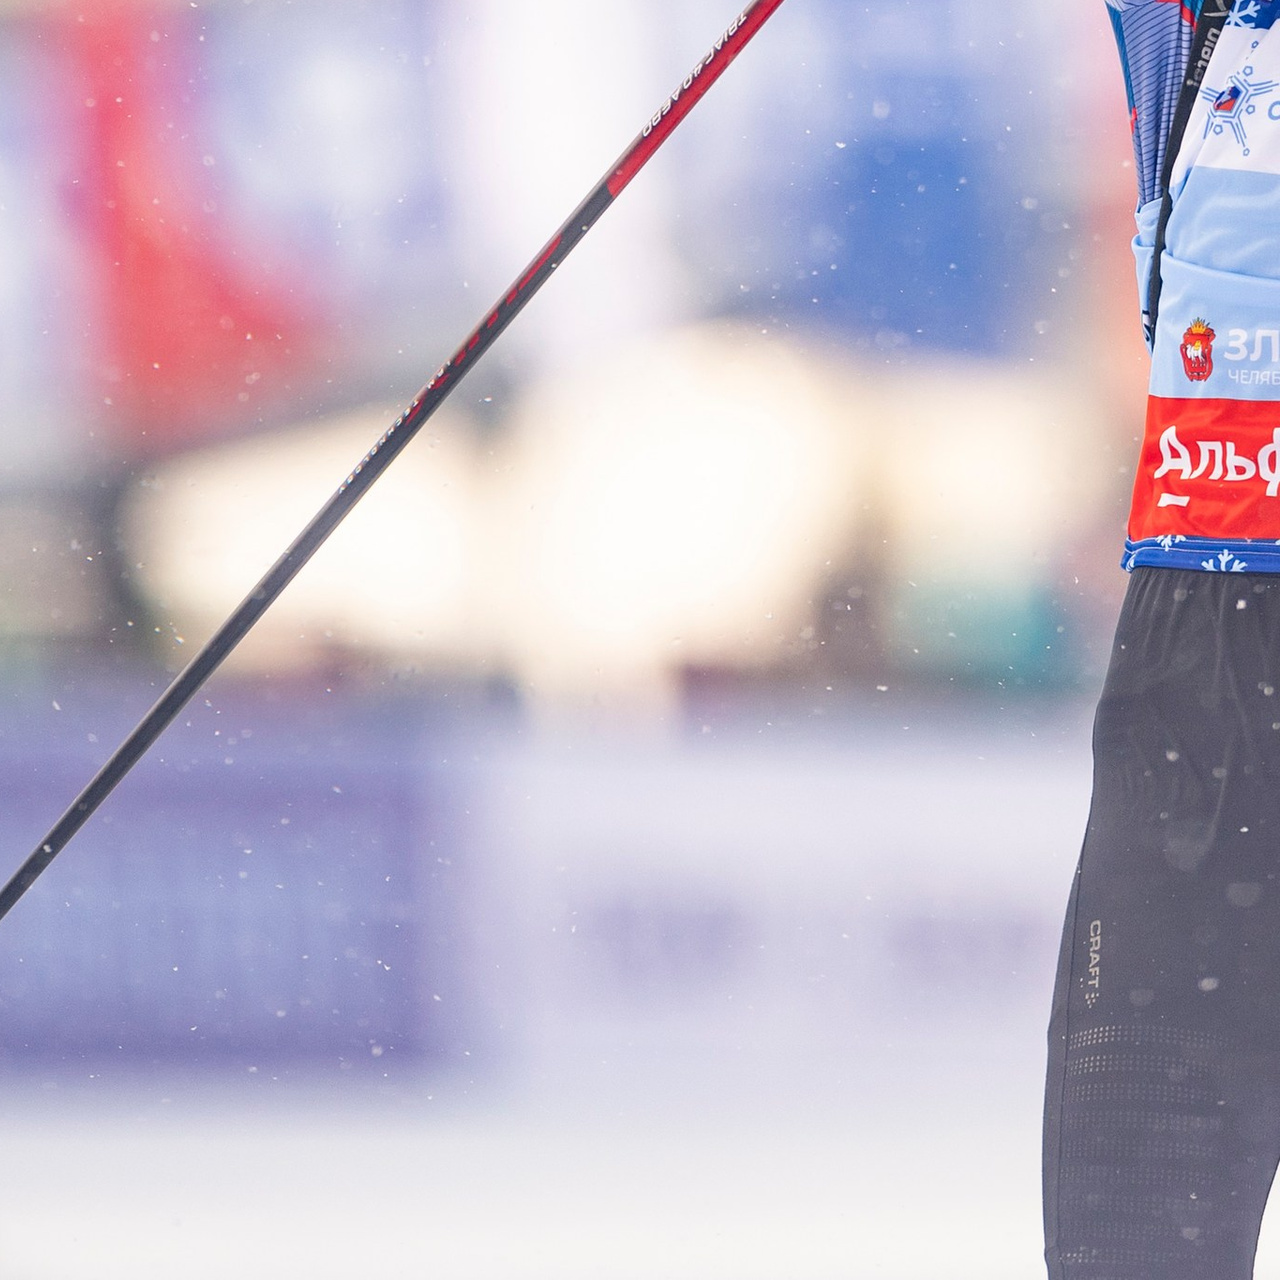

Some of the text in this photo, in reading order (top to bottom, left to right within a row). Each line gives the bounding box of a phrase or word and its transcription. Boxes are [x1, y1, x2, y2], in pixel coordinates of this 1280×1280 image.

[705, 13, 747, 65] TRIAC
[642, 86, 682, 138] AERO
[1088, 920, 1101, 989] CRAFT
